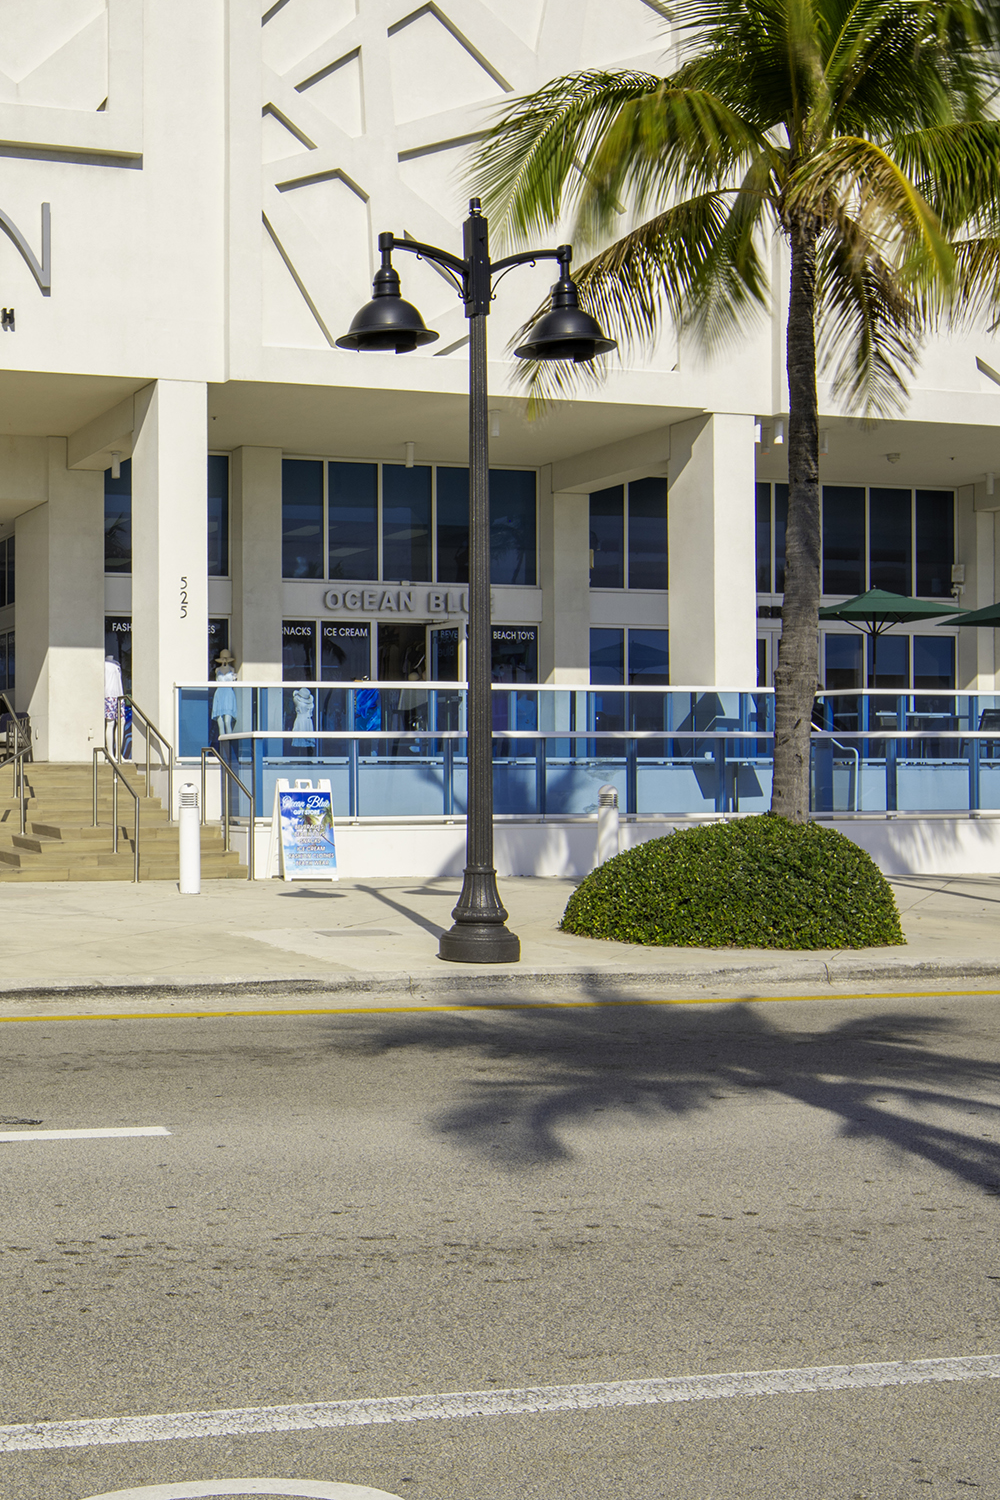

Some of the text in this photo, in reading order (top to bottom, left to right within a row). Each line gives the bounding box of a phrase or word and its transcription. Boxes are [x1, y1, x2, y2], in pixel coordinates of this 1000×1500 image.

[179, 576, 189, 619] 525
[324, 589, 416, 613] OCEAN
[112, 622, 132, 632] FASH
[323, 627, 368, 637] ICE CREAM
[492, 630, 535, 640] BEACH TOYS
[282, 795, 330, 808] Ocean Blue
